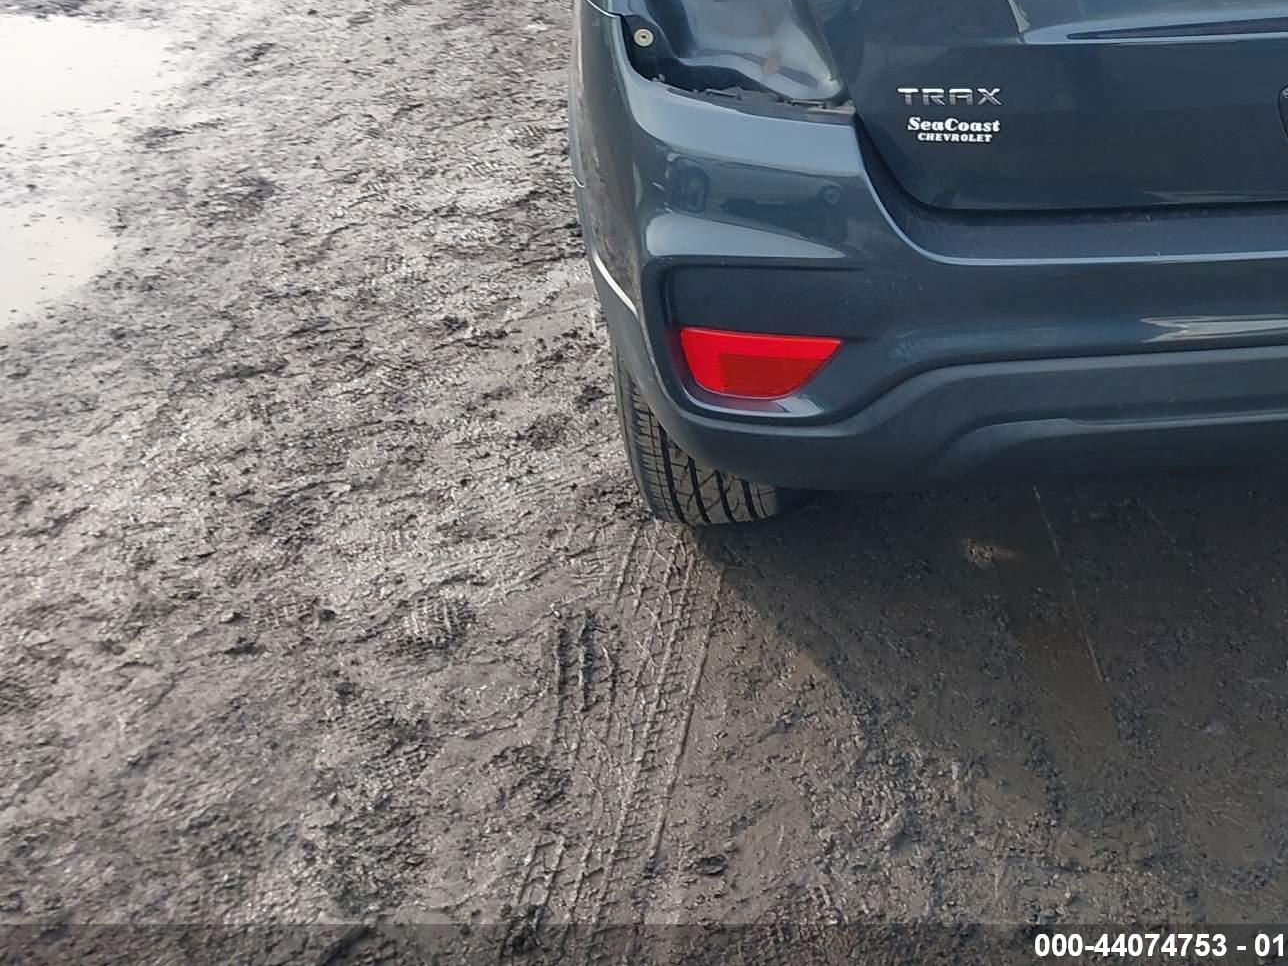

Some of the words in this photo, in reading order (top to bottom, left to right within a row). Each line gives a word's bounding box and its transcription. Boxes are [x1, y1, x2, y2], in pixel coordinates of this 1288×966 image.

[897, 88, 1002, 106] TRAX
[908, 117, 1001, 132] SeaCoast
[917, 133, 993, 142] CHEVROLET
